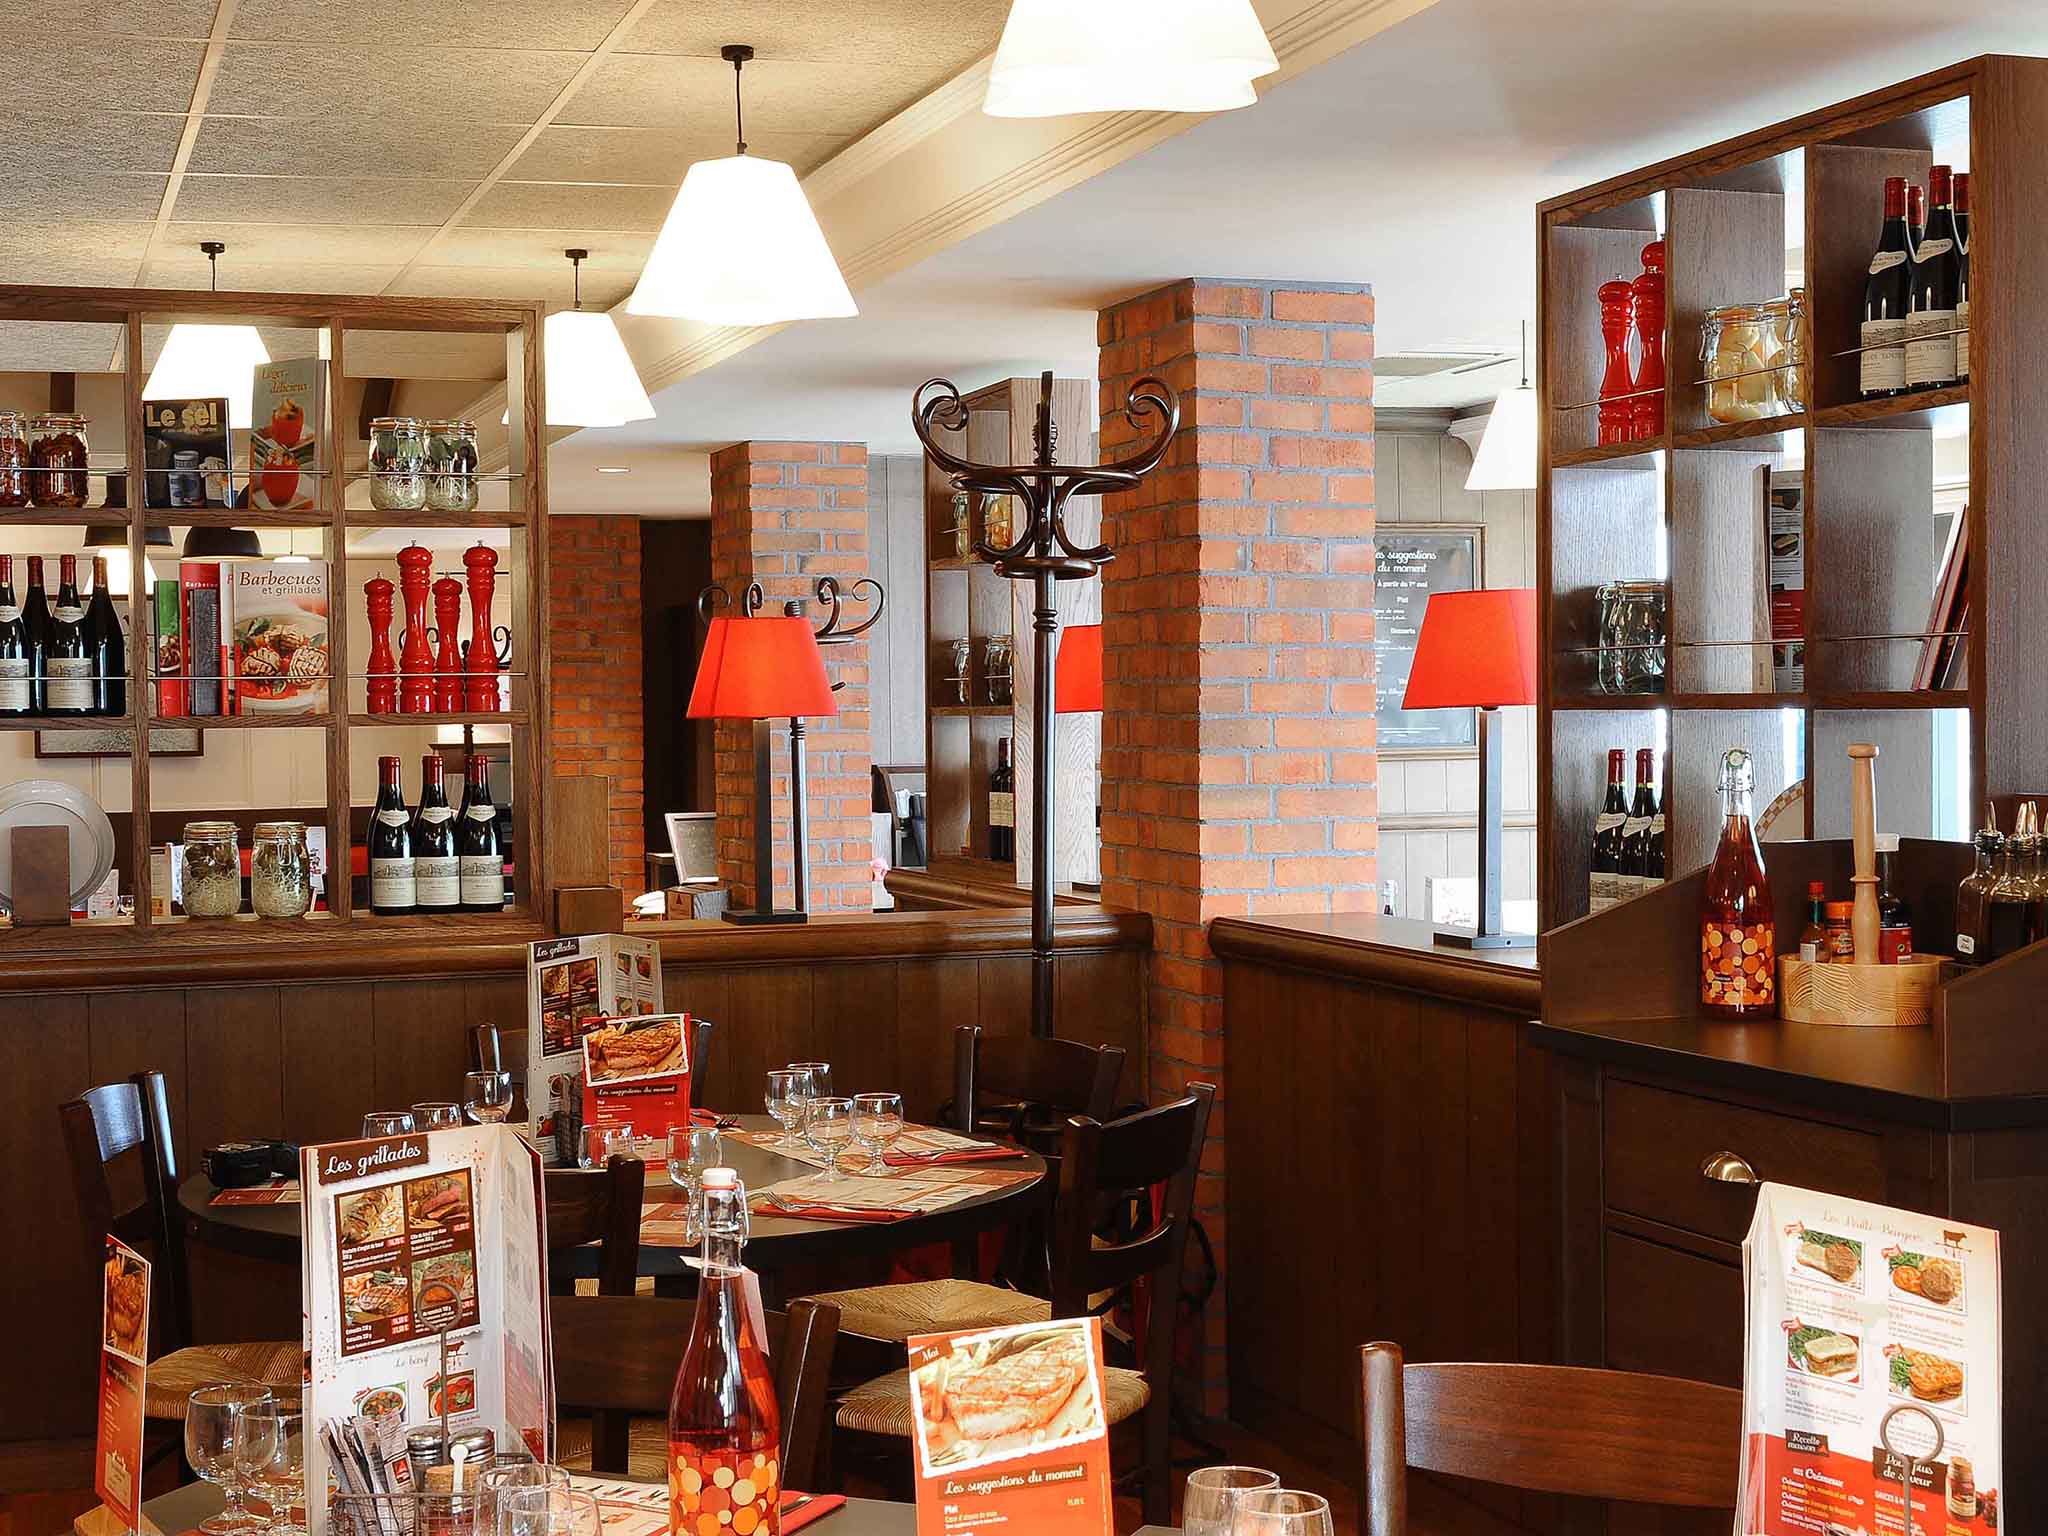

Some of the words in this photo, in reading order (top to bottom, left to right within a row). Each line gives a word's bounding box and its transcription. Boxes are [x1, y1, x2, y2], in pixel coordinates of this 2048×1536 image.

[146, 404, 176, 427] Le
[181, 402, 218, 428] sel
[1387, 550, 1437, 564] suggestions
[1377, 561, 1390, 572] du
[1393, 563, 1426, 573] moment
[240, 571, 321, 587] Barbecues
[262, 587, 273, 595] et
[275, 585, 321, 597] grillades
[324, 1157, 353, 1176] Les
[357, 1144, 421, 1176] grillades
[921, 1347, 940, 1362] Mai
[944, 1481, 964, 1495] Les
[967, 1474, 1025, 1495] suggestions
[1028, 1469, 1042, 1484] du
[1045, 1465, 1084, 1481] moment
[1883, 1466, 1896, 1477] de
[1897, 1473, 1932, 1487] sveur
